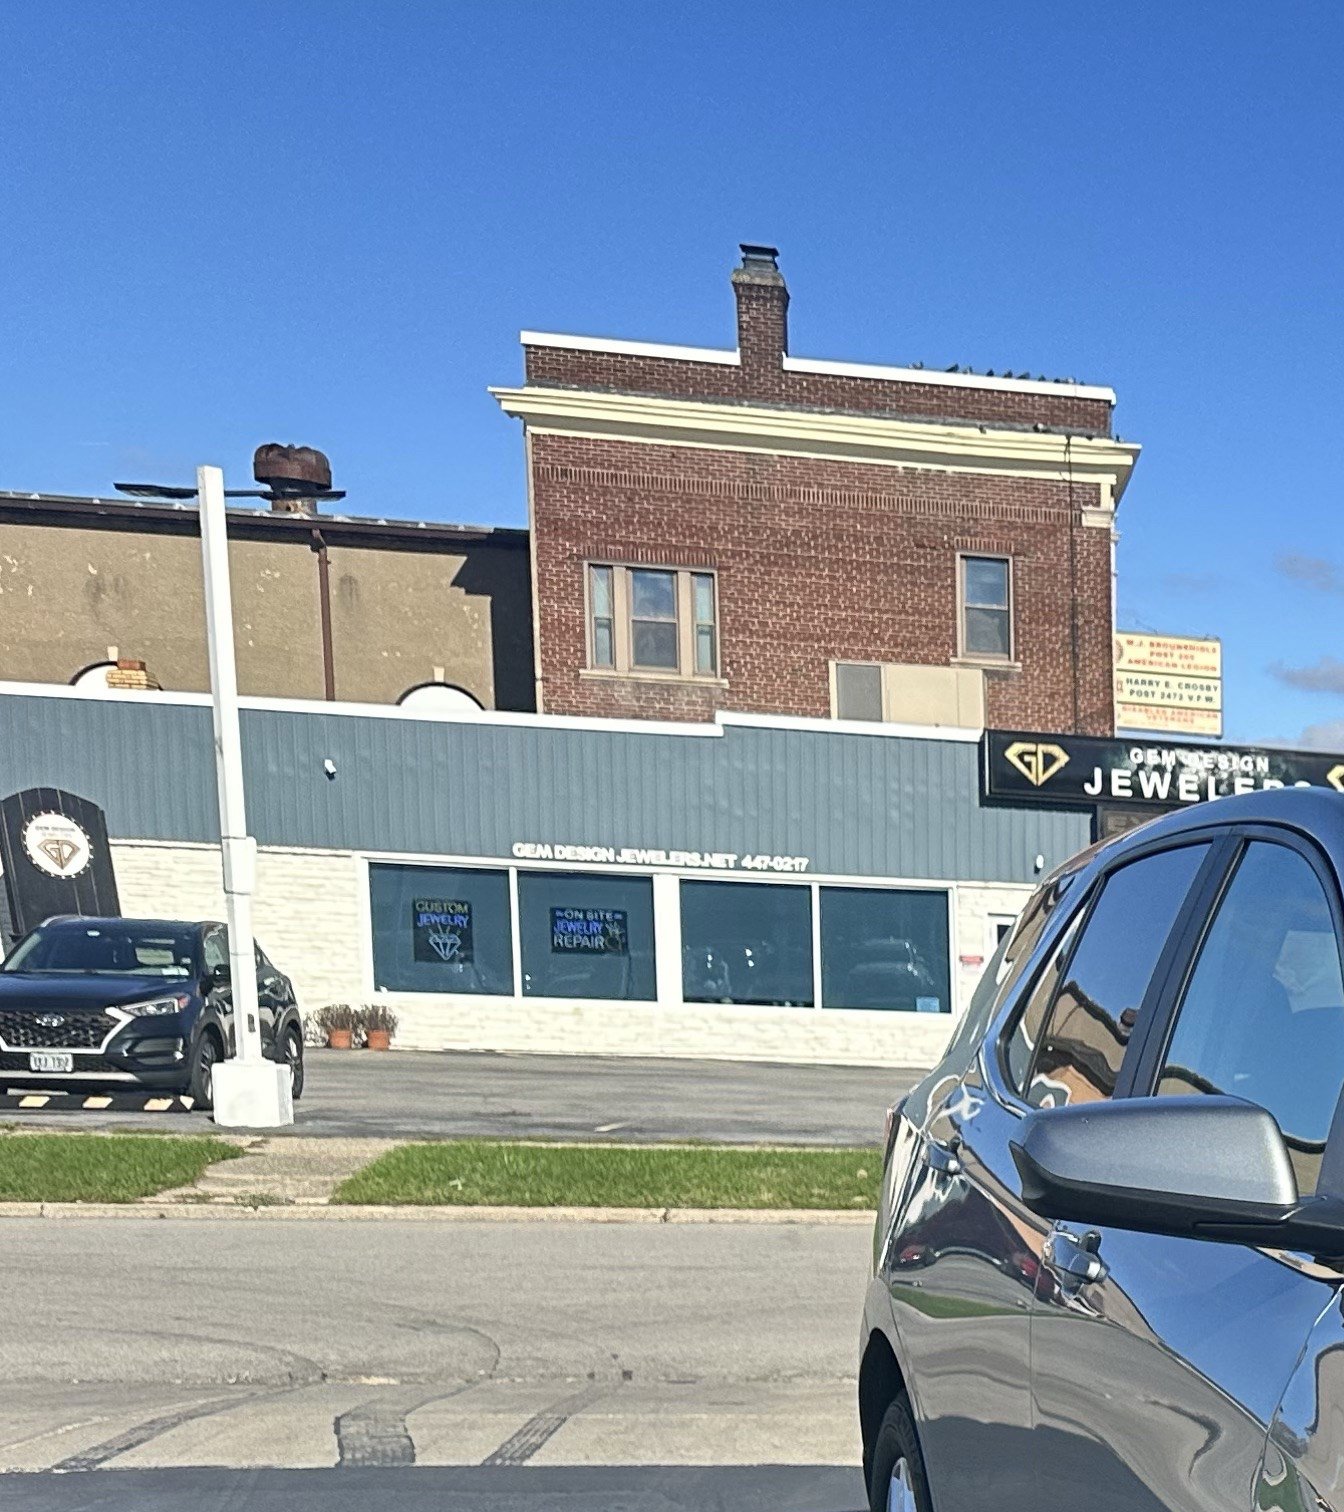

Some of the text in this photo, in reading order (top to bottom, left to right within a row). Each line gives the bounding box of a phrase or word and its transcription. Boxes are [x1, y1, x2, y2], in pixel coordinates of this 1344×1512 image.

[1125, 678, 1161, 688] HARRY
[1177, 682, 1219, 692] CROSBY
[1129, 689, 1155, 698] POST
[1129, 747, 1269, 773] GEM DESIGN
[1083, 767, 1311, 802] JEWELE
[512, 842, 554, 859] GEM
[554, 844, 615, 863] DESIGN
[416, 900, 469, 913] CUSTOM
[564, 909, 584, 920] ON
[417, 912, 470, 928] JEWELRY
[554, 919, 604, 935] JEWELRY
[553, 934, 605, 950] REPAIR
